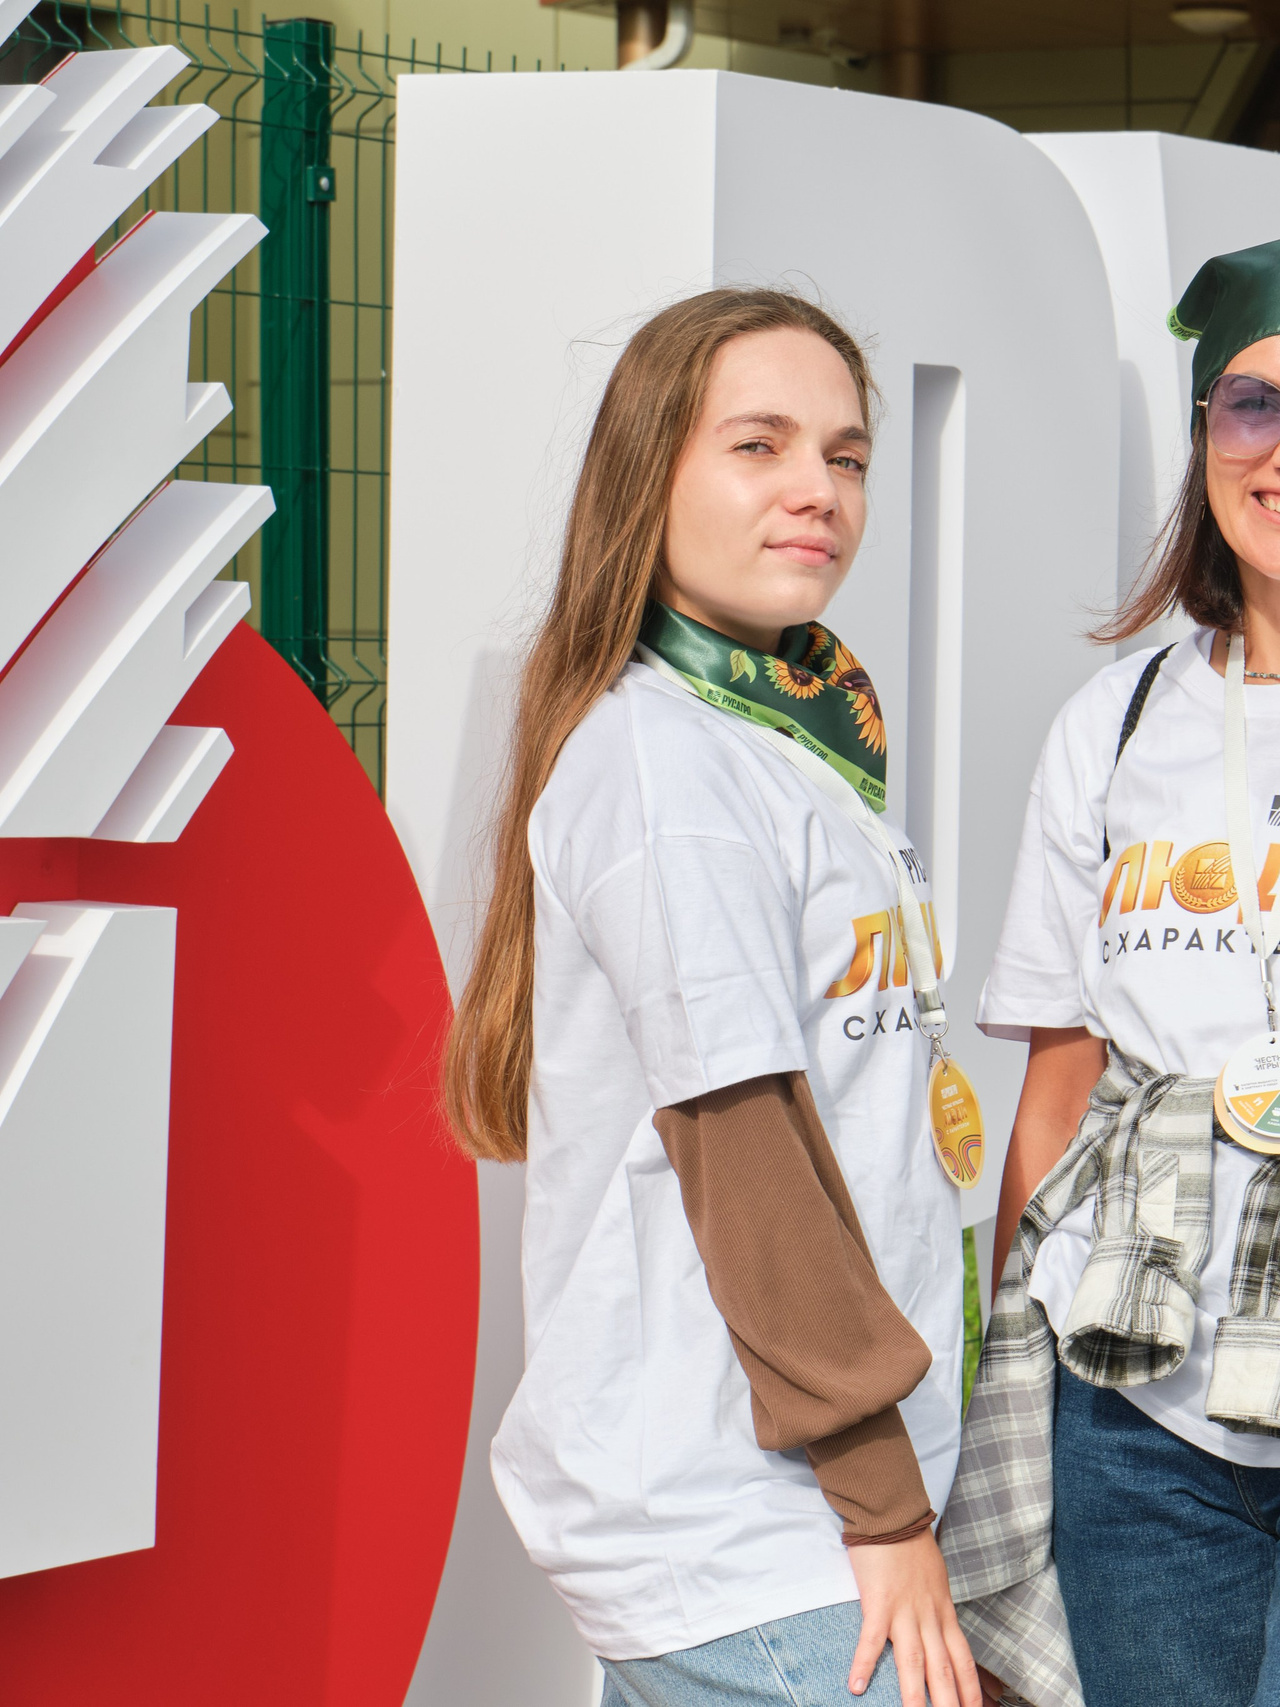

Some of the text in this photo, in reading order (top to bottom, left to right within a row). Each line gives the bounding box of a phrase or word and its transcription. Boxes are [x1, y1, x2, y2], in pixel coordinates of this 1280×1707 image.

[722, 694, 752, 716] РУСАГРО
[797, 733, 829, 761] РУСАГРО
[843, 1015, 866, 1041] С
[1254, 1061, 1280, 1071] ИГРЫ
